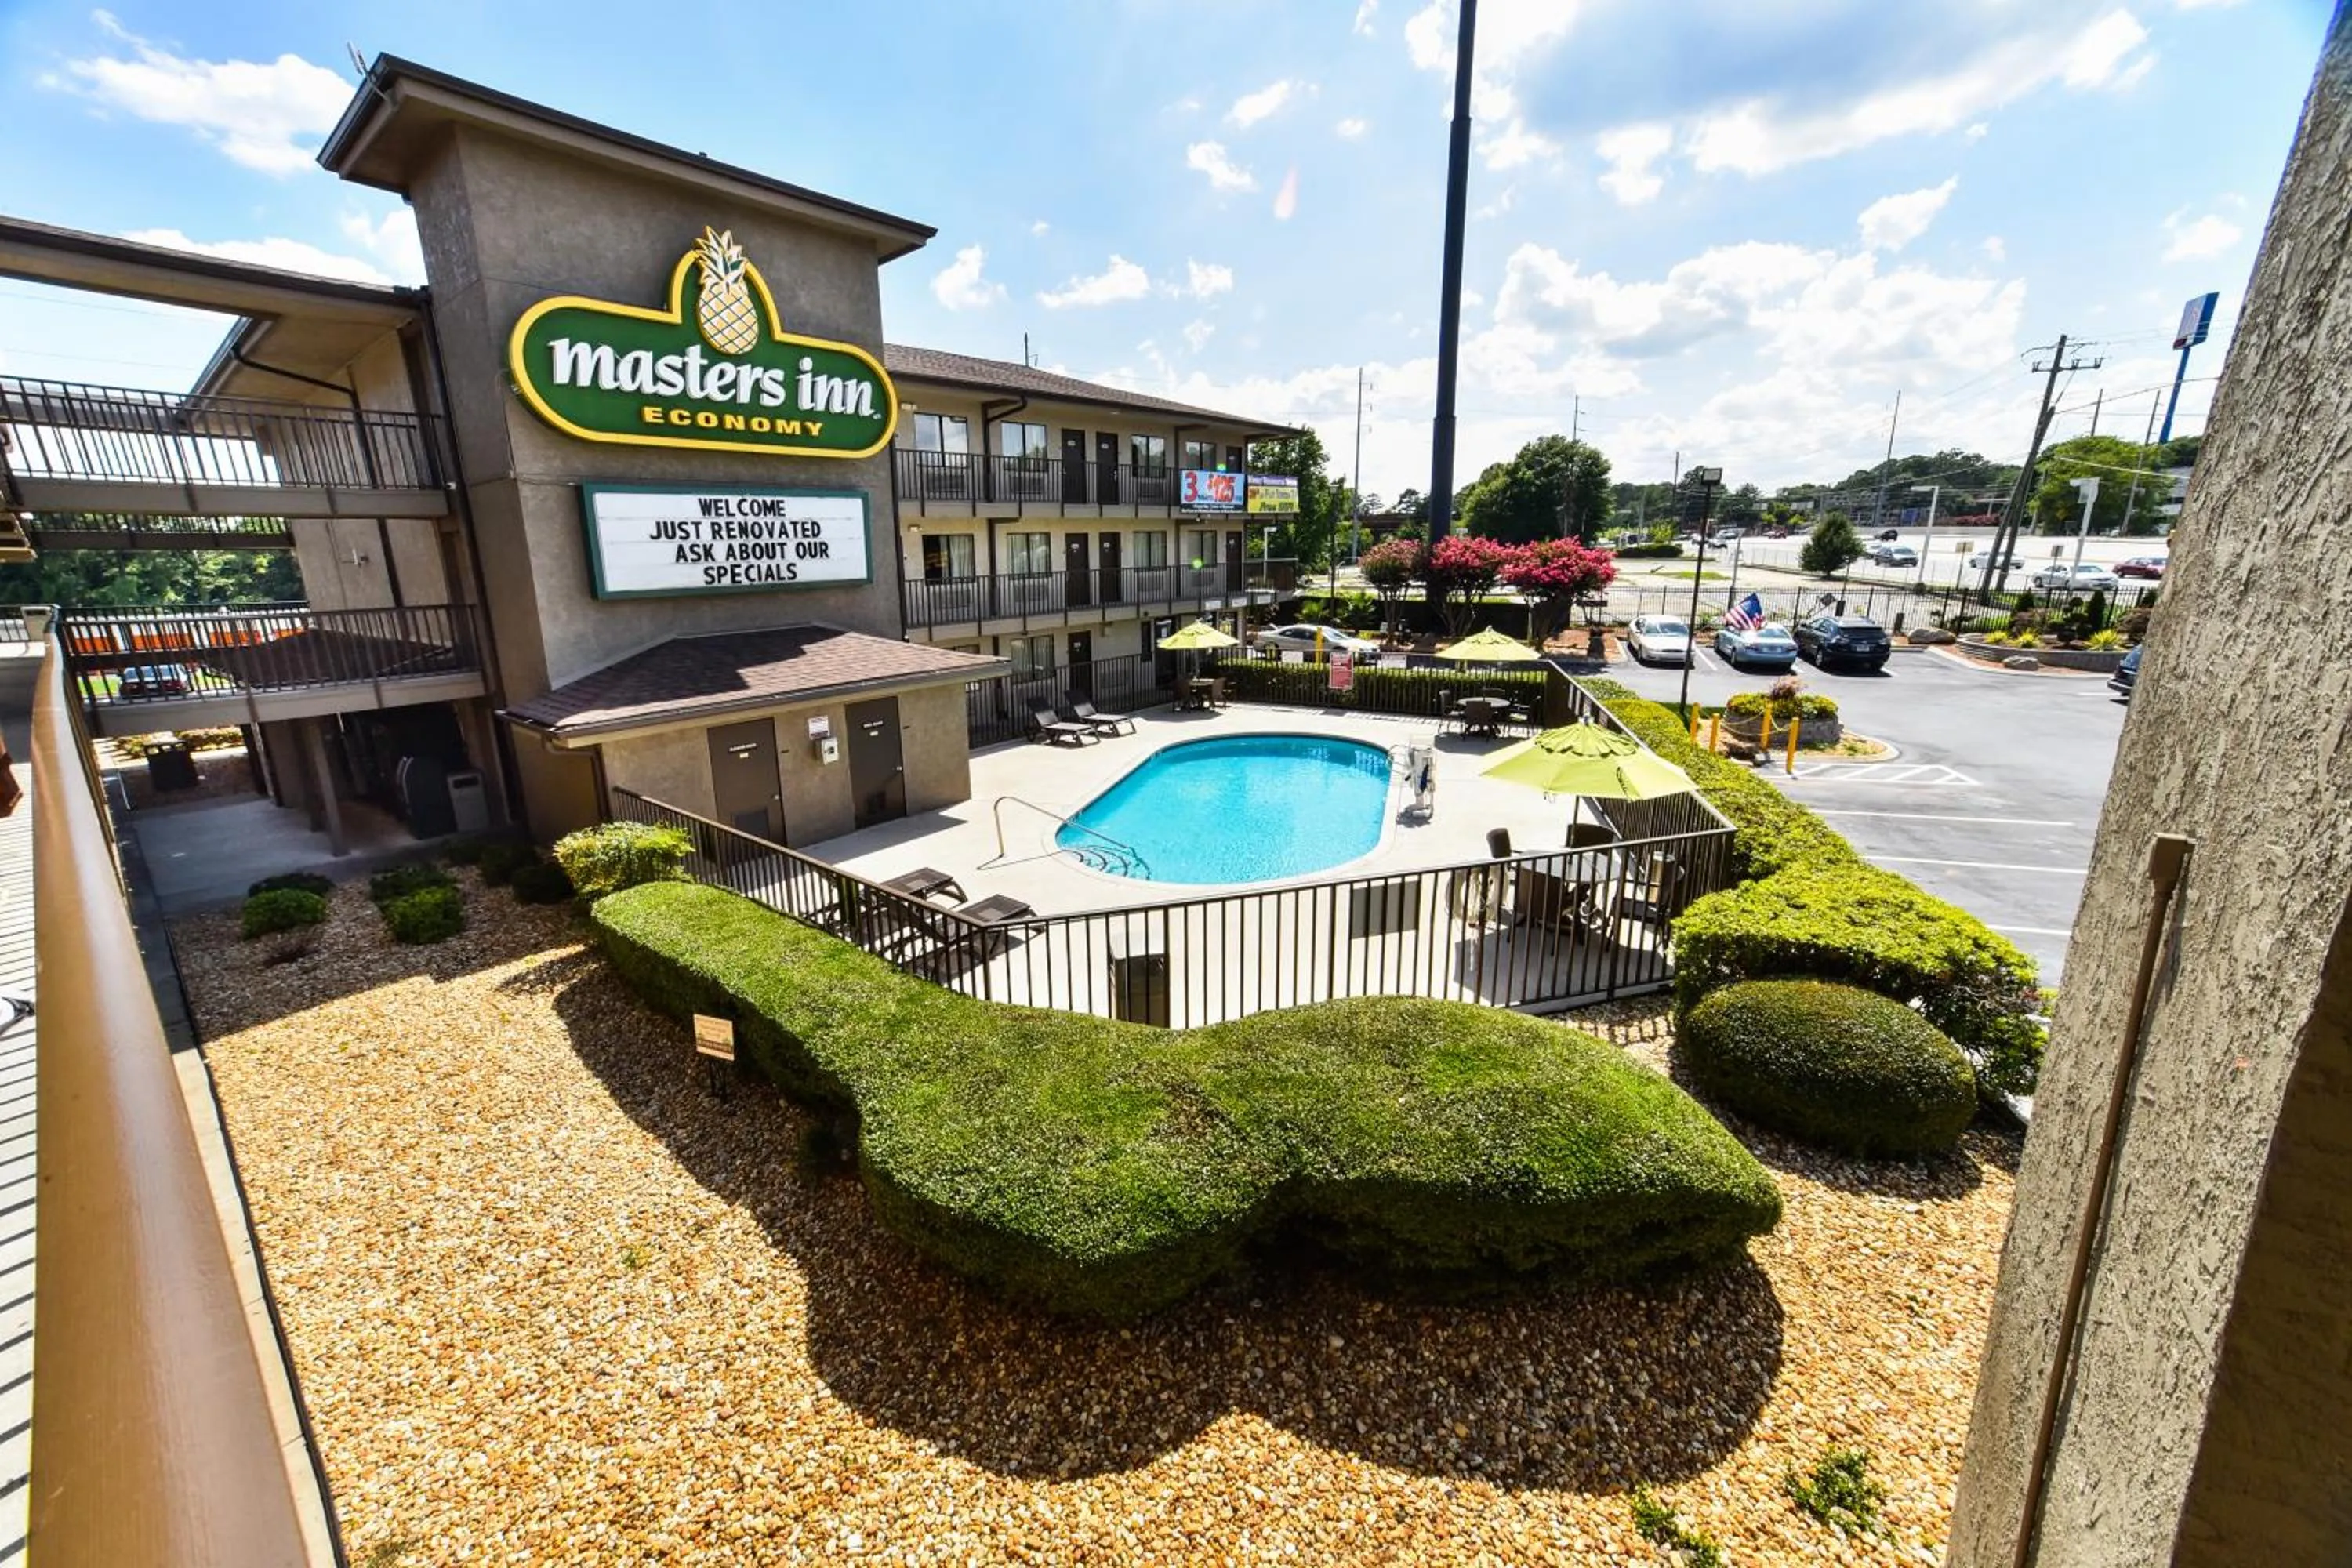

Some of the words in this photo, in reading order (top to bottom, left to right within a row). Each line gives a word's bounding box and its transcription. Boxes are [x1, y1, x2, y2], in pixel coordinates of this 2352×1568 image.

[548, 338, 785, 406] masters
[644, 407, 823, 437] ECONOMY
[699, 498, 786, 517] WELCOME
[650, 521, 702, 540] JUST
[710, 521, 821, 540] RENOVATED
[675, 543, 716, 563] ASK
[725, 542, 787, 562] ABOUT
[795, 541, 829, 559] OUR
[703, 563, 797, 585] SPECIALS
